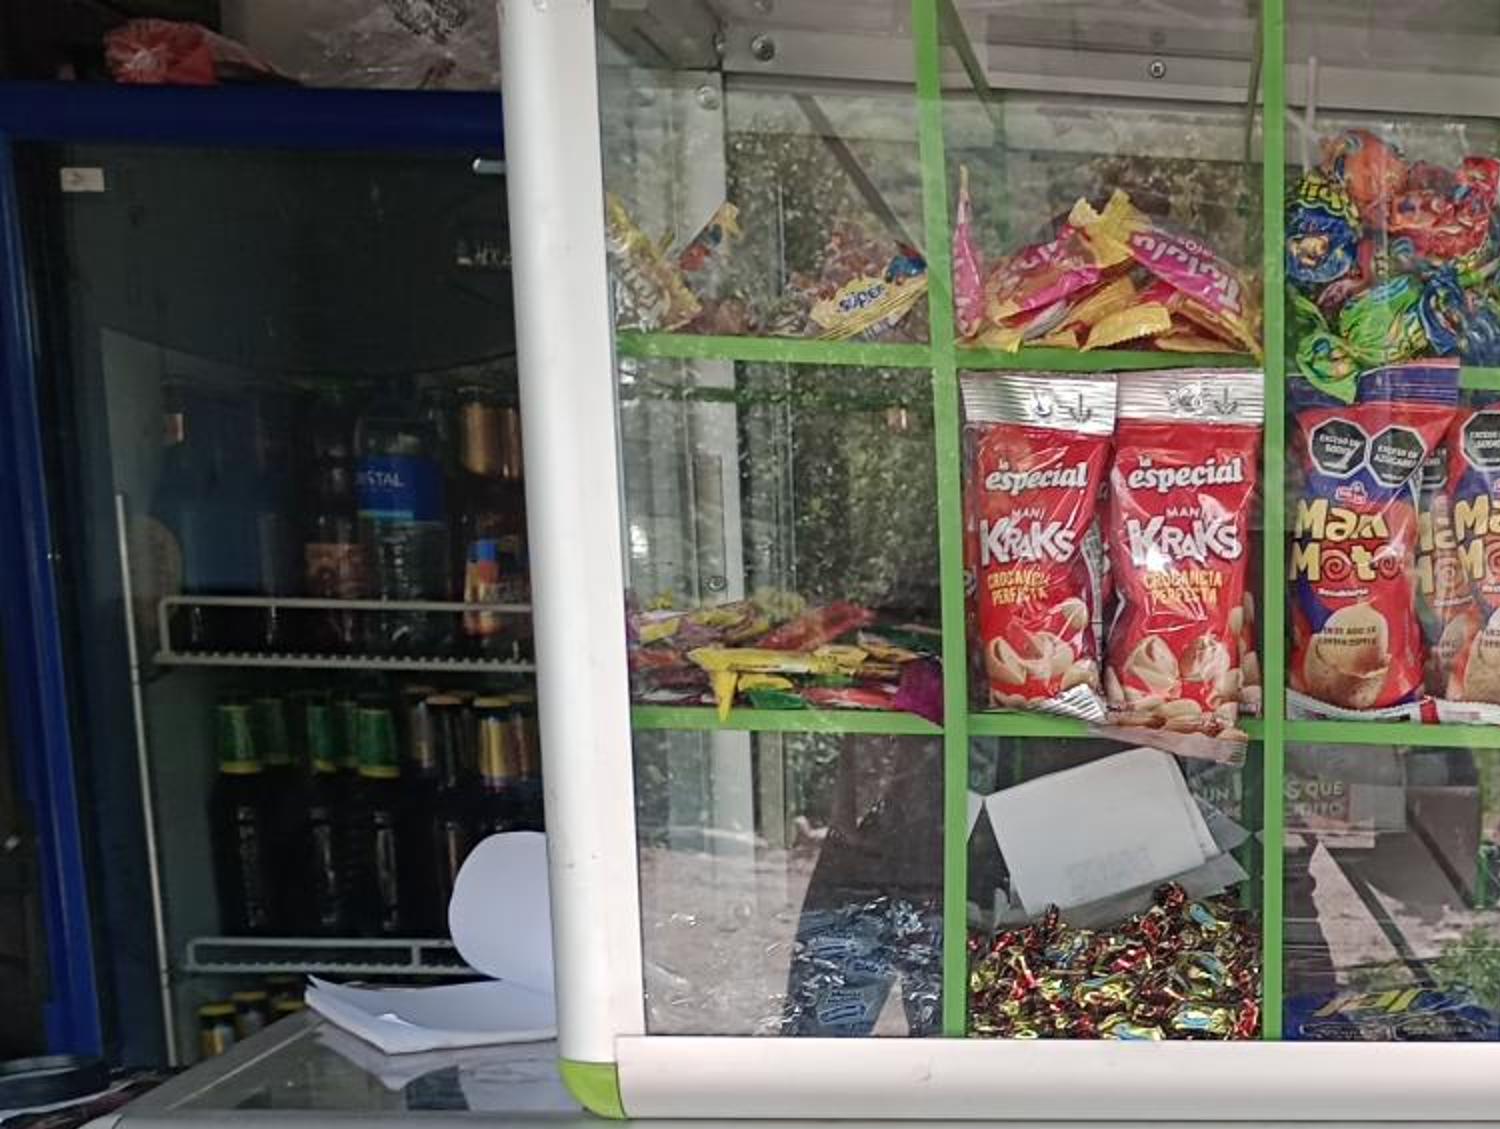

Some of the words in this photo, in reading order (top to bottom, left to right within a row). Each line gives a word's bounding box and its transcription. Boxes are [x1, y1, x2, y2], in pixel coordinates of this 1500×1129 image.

[985, 461, 1088, 496] especial
[1128, 457, 1244, 493] especial
[1305, 780, 1344, 797] QUE
